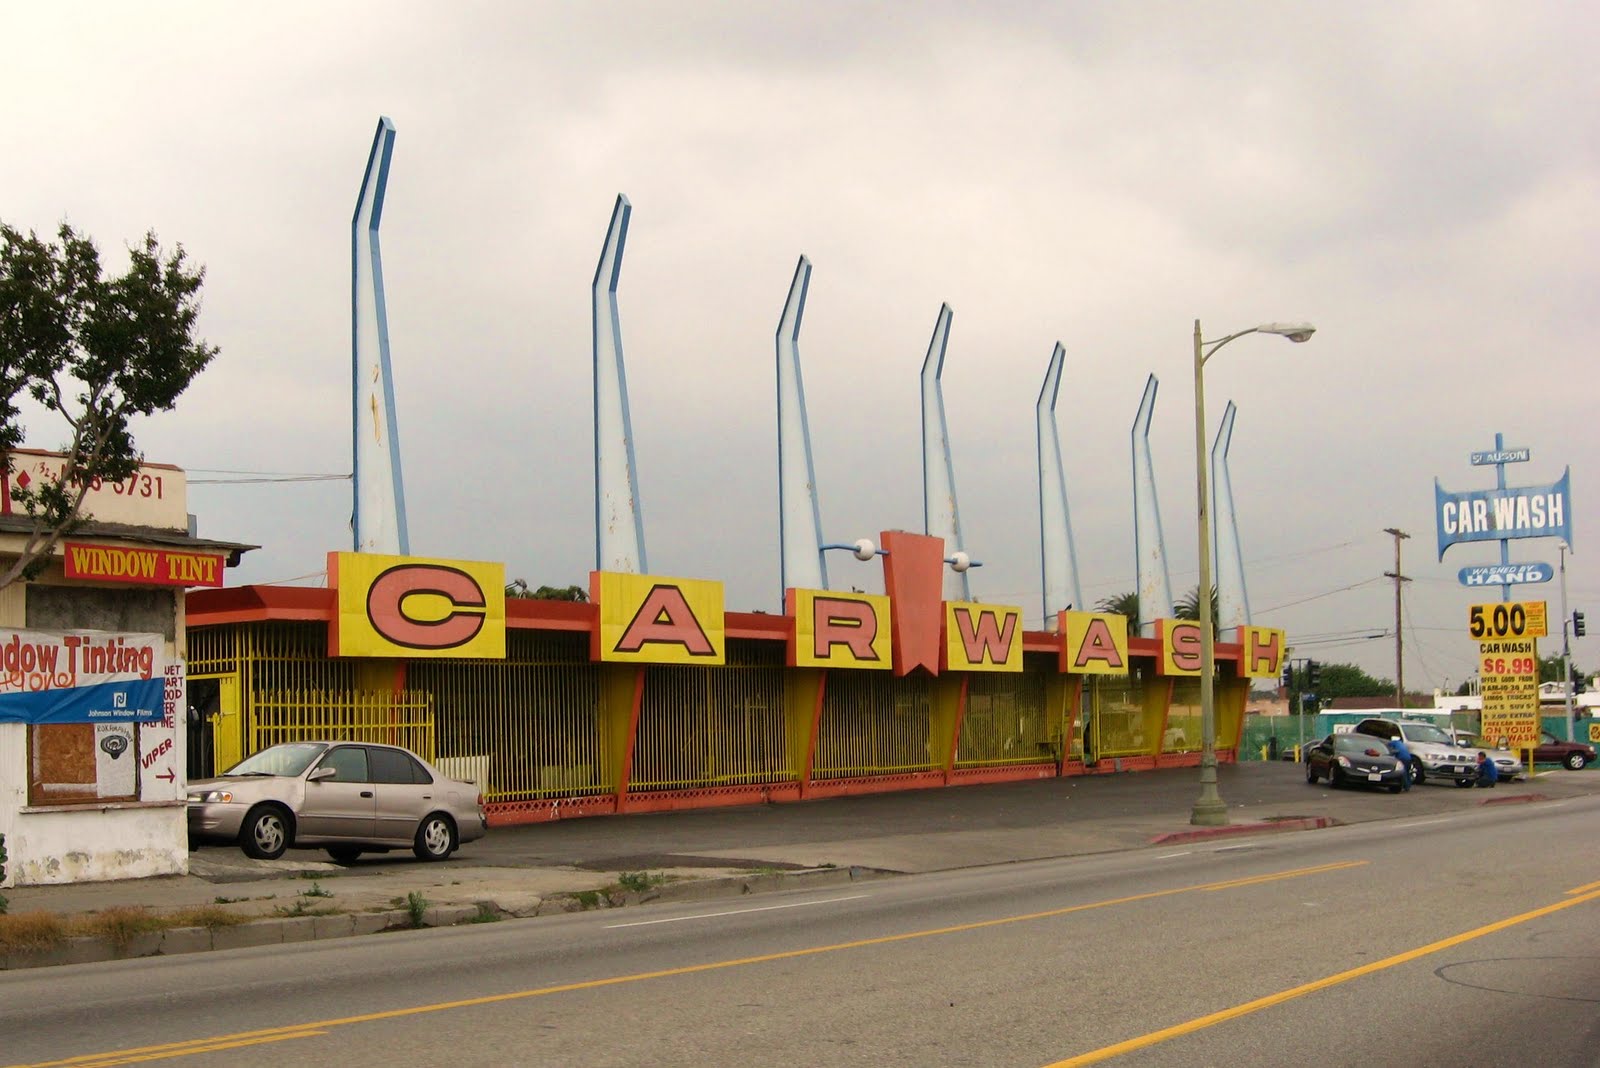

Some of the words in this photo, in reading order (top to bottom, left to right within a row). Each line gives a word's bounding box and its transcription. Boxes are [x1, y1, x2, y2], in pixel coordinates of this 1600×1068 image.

[1443, 499, 1488, 535] CAR
[1494, 493, 1563, 531] WASH
[71, 547, 158, 578] WINDOW
[166, 554, 217, 582] TINT
[1472, 566, 1517, 575] WASHED
[1519, 565, 1535, 573] BY
[1467, 571, 1543, 585] HAND
[1470, 604, 1526, 637] 5.00
[1480, 643, 1500, 653] CAR
[1502, 642, 1532, 653] WASH
[0, 634, 58, 673] dow
[64, 636, 153, 680] Tinting
[1484, 657, 1534, 674] $6.99
[88, 709, 112, 717] Johnson
[137, 708, 153, 716] Films
[1507, 734, 1537, 742] WASH
[142, 738, 173, 769] VIPER
